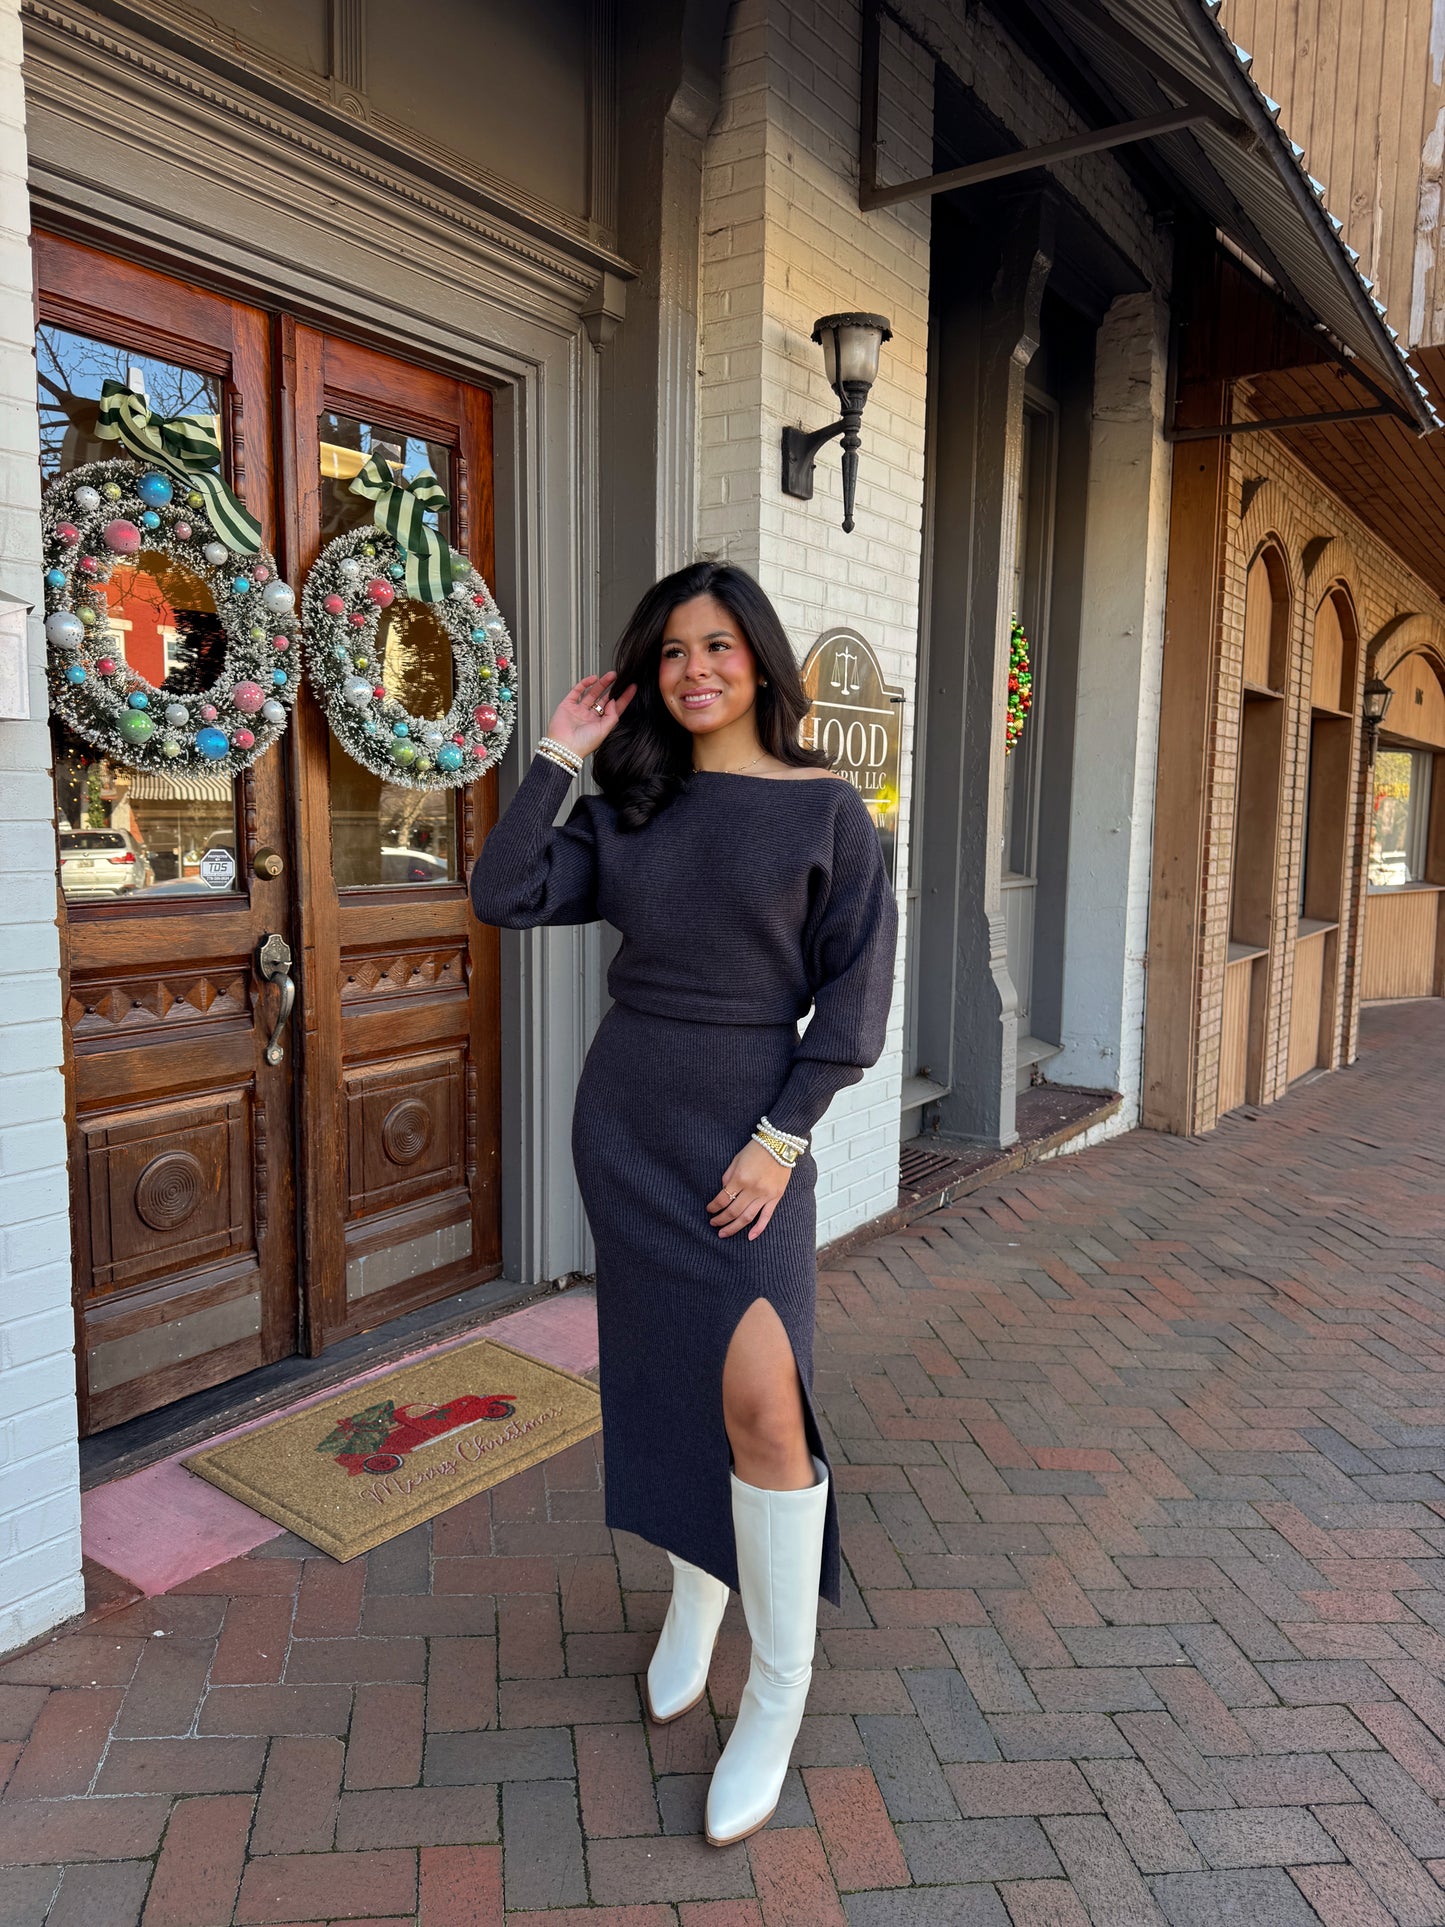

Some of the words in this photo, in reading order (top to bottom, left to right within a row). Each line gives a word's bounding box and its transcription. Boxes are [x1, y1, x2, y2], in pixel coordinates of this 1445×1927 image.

[799, 717, 888, 767] HOOD
[865, 771, 887, 790] LLC
[209, 863, 228, 872] TDS
[359, 1460, 457, 1504] Merry
[456, 1407, 563, 1462] Christmas
